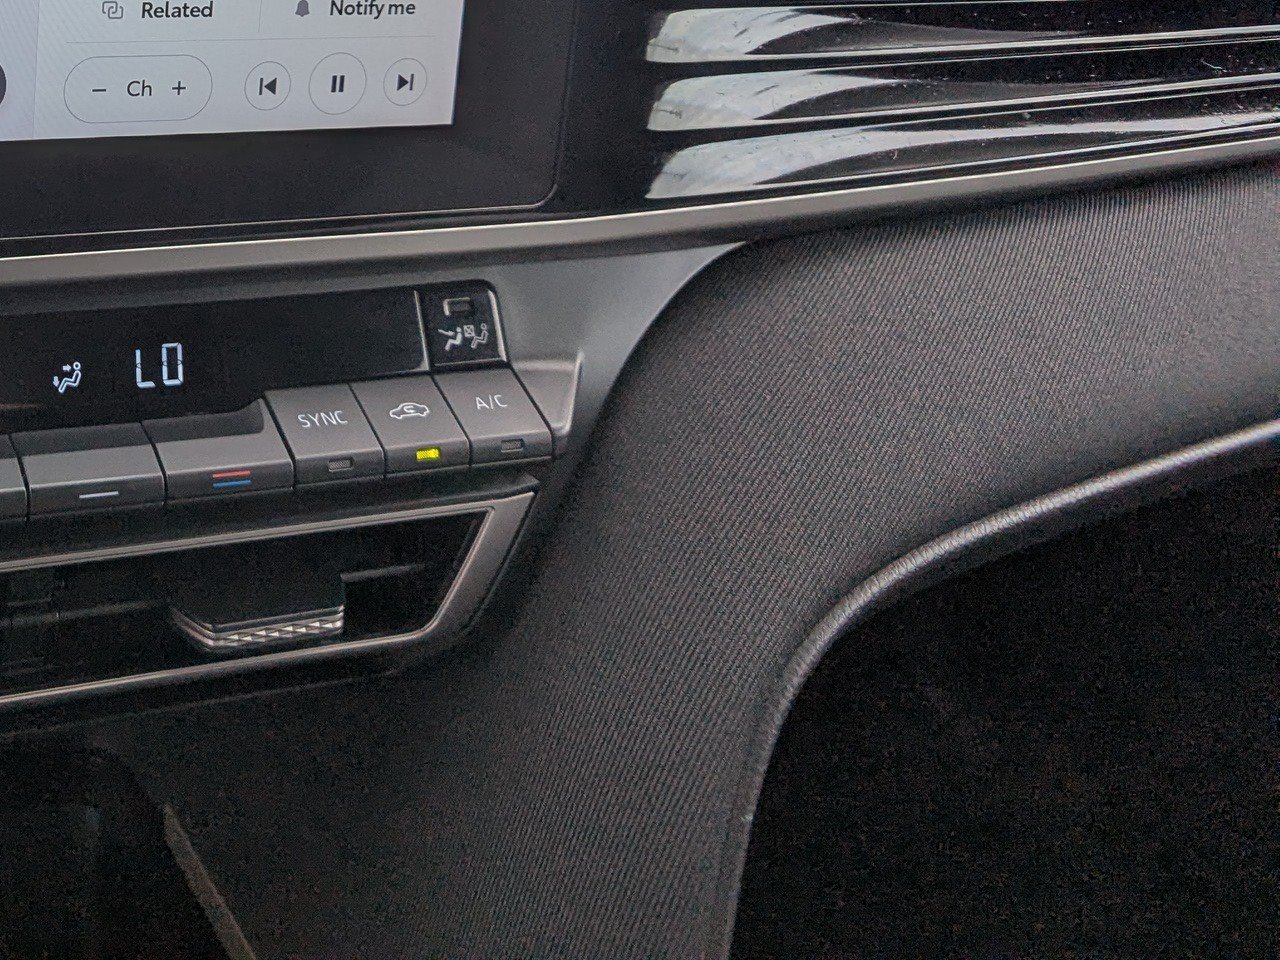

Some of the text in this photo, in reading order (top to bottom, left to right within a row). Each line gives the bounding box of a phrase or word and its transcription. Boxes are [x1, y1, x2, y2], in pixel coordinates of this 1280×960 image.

[141, 0, 214, 20] Related
[329, 0, 416, 21] Notify me
[126, 79, 153, 98] Ch
[475, 393, 508, 412] A/C
[297, 408, 348, 430] SYNC
